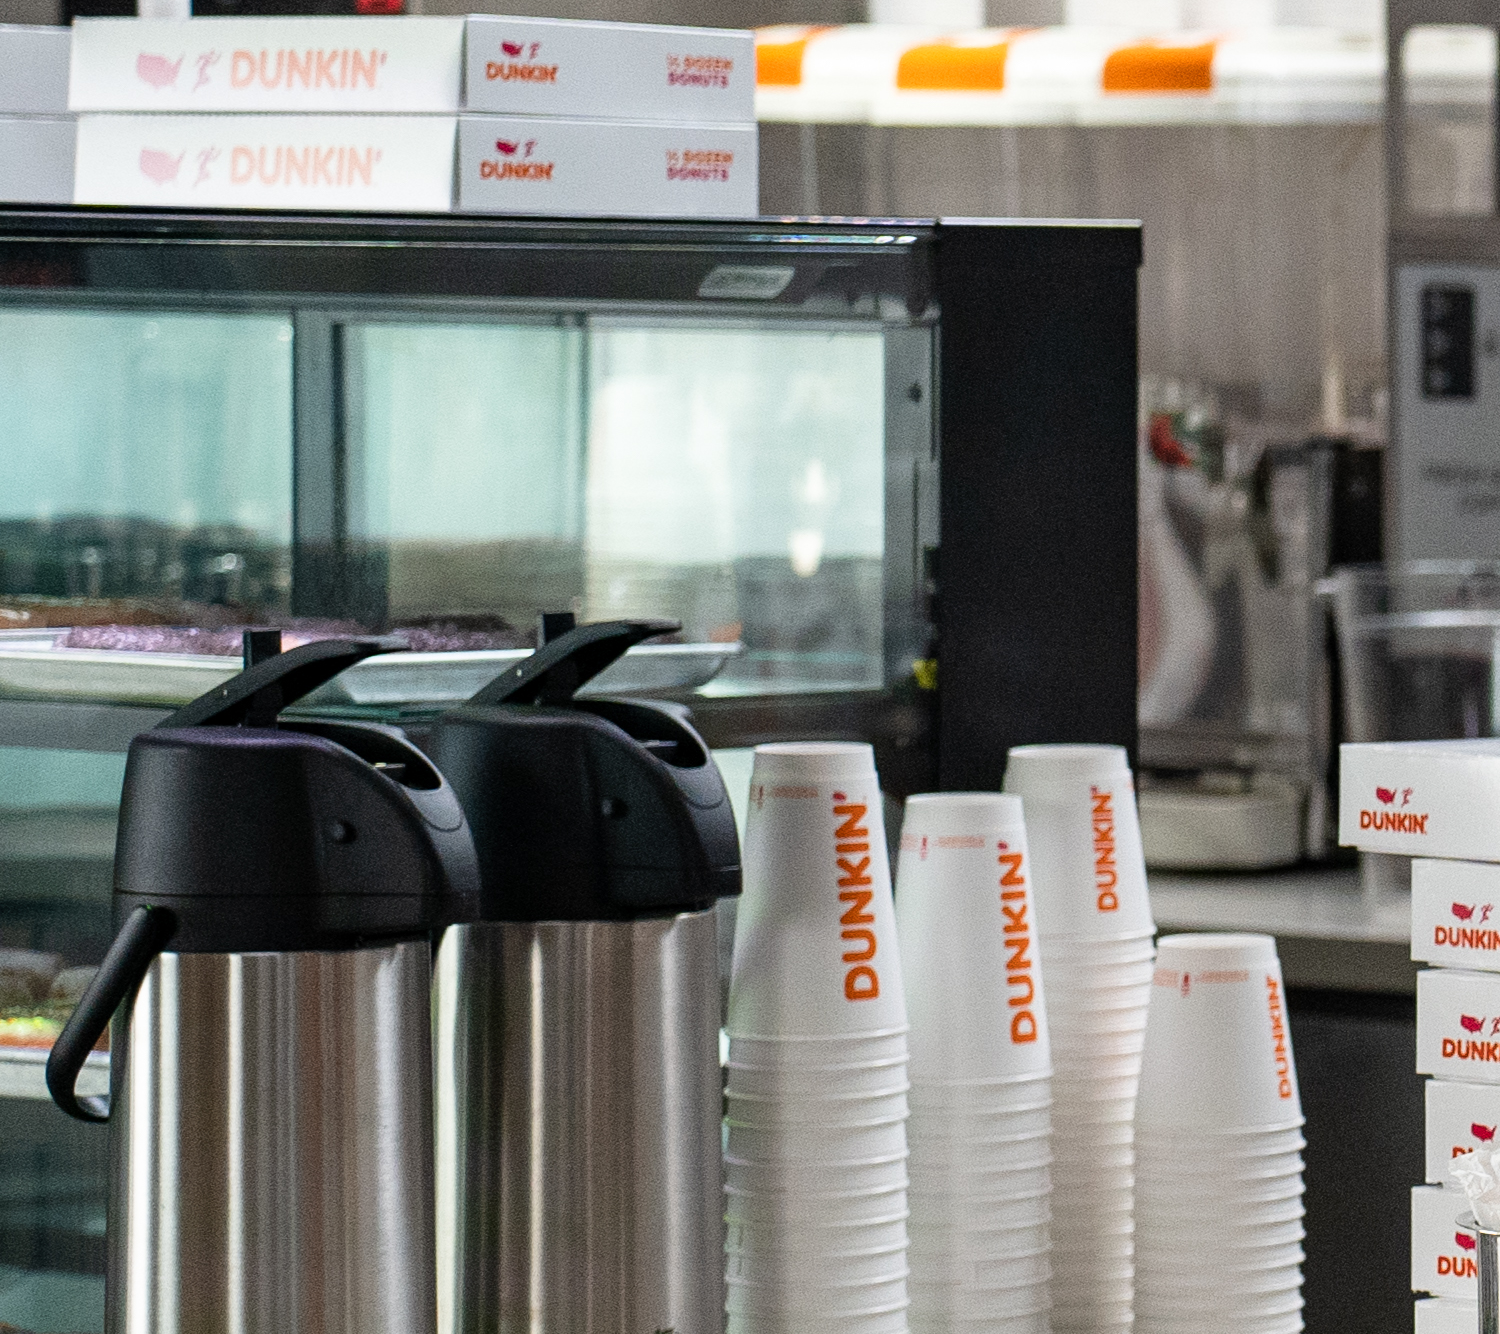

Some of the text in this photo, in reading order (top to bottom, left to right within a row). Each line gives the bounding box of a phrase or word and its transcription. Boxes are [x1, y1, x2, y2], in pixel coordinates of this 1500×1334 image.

[229, 48, 388, 90] DUNKIN'
[229, 144, 384, 187] DUNKIN'
[1091, 785, 1120, 914] DUNKIN'
[1360, 809, 1430, 835] DUNKIN'
[832, 790, 880, 1002] DUNKIN'
[997, 840, 1038, 1045] DUNKIN'
[1266, 974, 1292, 1100] DUNKIN'
